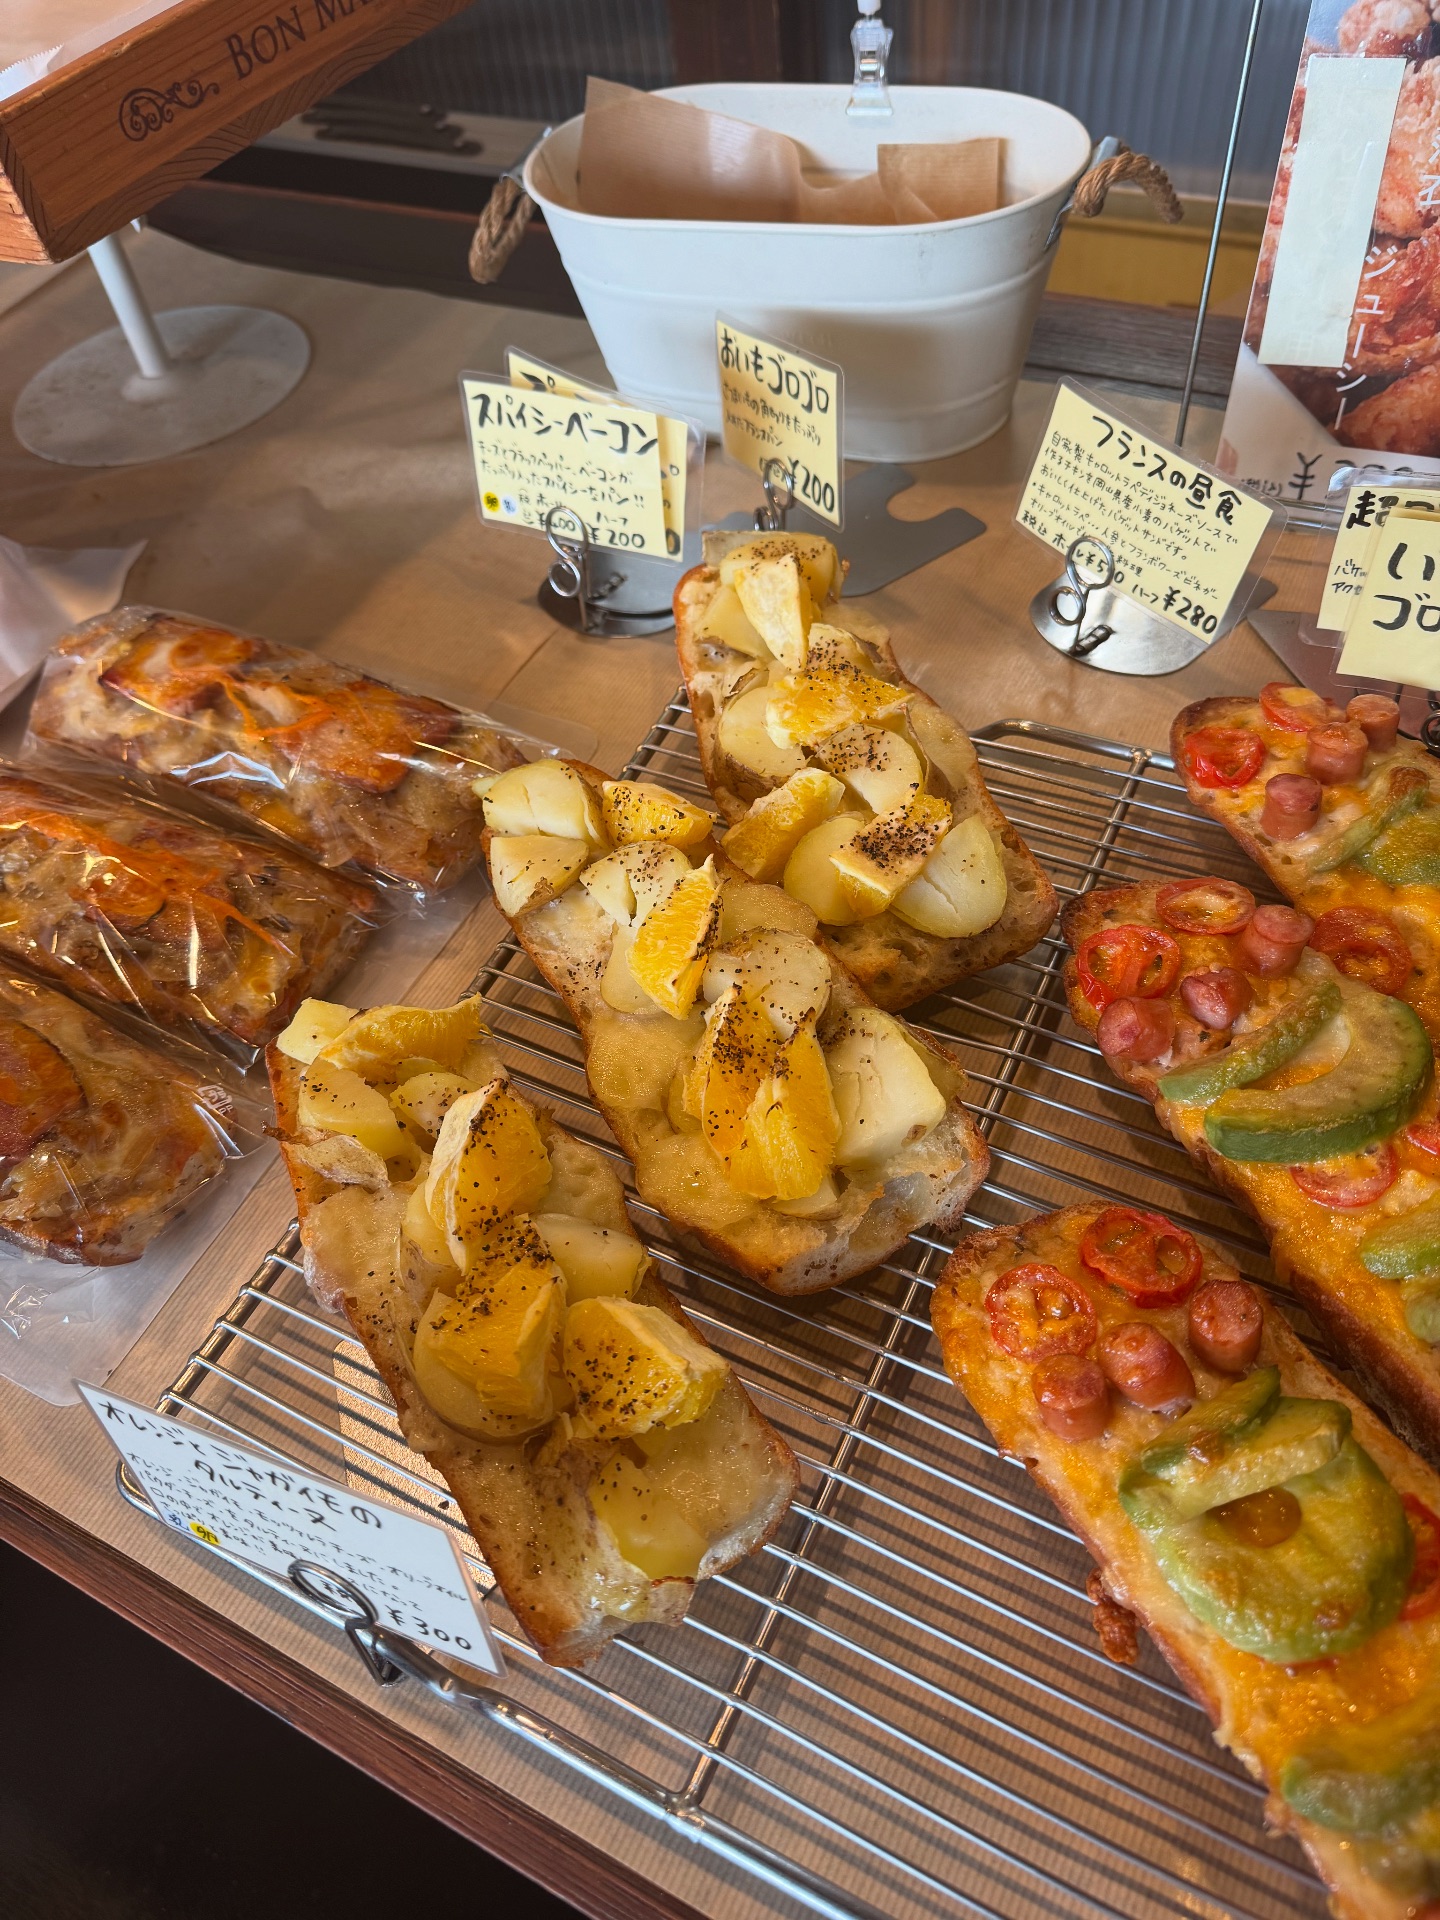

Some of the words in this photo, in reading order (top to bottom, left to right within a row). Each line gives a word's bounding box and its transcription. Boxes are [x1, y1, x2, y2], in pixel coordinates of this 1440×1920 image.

[226, 5, 306, 80] BON
[314, 0, 377, 31] M
[720, 328, 830, 414] おいもゴロゴロ
[1334, 245, 1398, 431] ジューシー
[471, 393, 659, 455] スパイシーベーコン
[1092, 415, 1242, 526] フランスの昼食
[596, 511, 628, 526] ハーフ
[1021, 510, 1047, 536] 税込
[1085, 551, 1125, 584] ¥50
[1131, 584, 1159, 604] ハーフ
[1163, 586, 1218, 634] ¥280
[98, 1401, 382, 1529] オレンジとジャガイモの
[194, 1459, 337, 1532] タルティーヌ
[386, 1605, 472, 1650] ¥300
